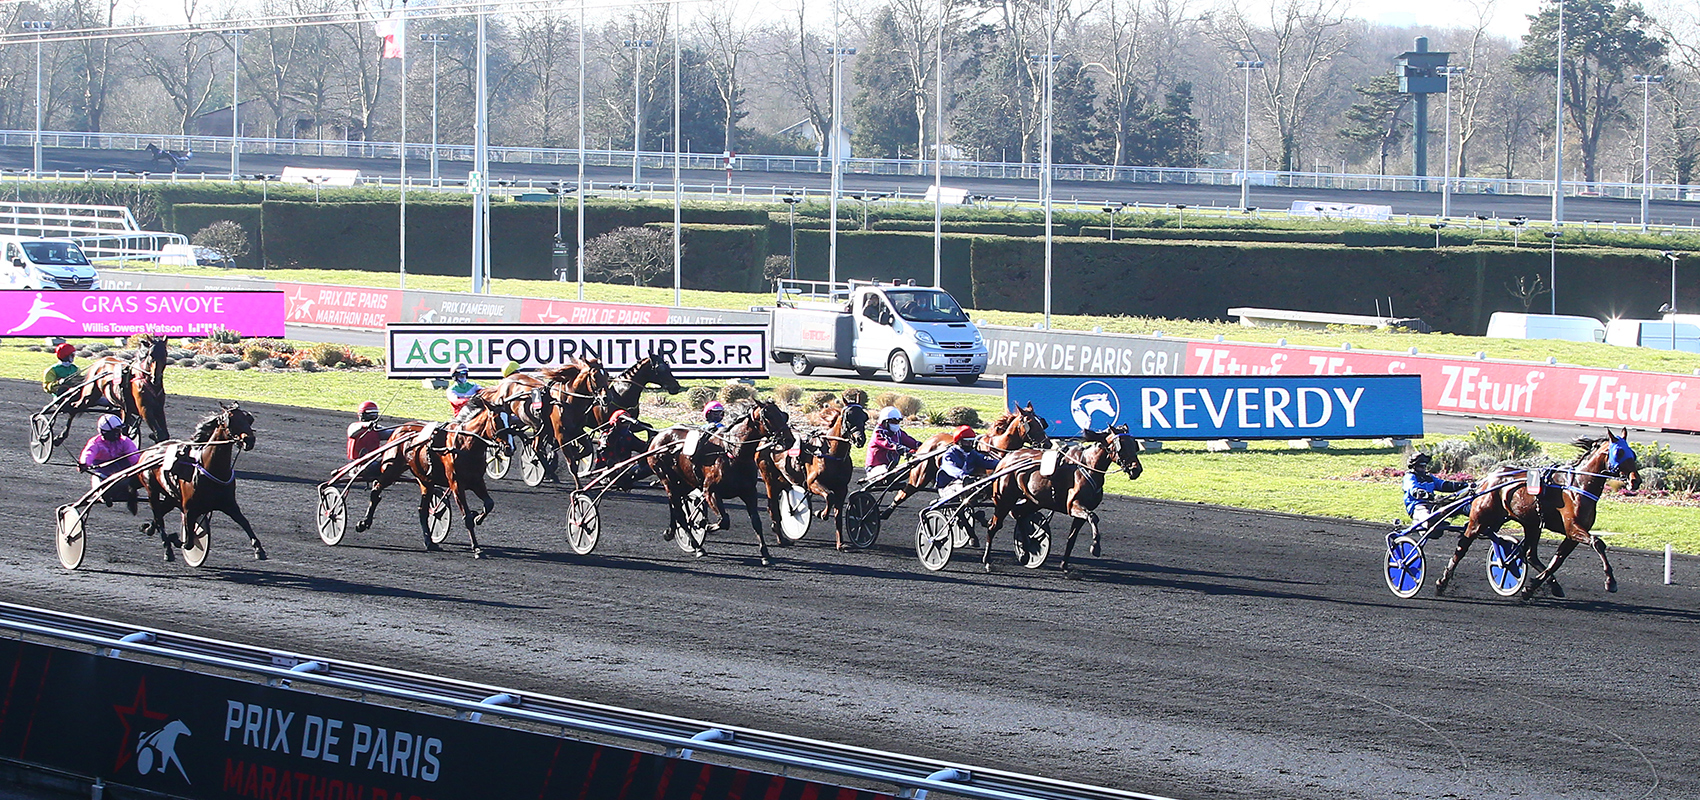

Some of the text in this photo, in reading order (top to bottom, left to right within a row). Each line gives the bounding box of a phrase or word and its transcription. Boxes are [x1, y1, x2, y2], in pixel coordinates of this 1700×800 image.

[82, 295, 225, 313] GRAS SAVOYE
[318, 290, 388, 309] PRIX DE PARIS
[440, 301, 505, 317] PRIX D'AMÉRIQUE
[315, 309, 386, 326] MARATHON RACE
[572, 307, 651, 324] PRIX DE PARIS
[405, 338, 752, 366] AGRIFOURNITURES.FR
[983, 338, 1020, 367] URF
[1022, 342, 1048, 369] PX
[1050, 344, 1076, 371] DE
[1079, 346, 1132, 374] PARIS
[1141, 350, 1168, 375] GR
[1438, 365, 1545, 413] ZEturf
[1574, 374, 1687, 424] ZEturf
[1141, 387, 1365, 429] REVERDY
[224, 700, 443, 782] PRIX DE PARIS
